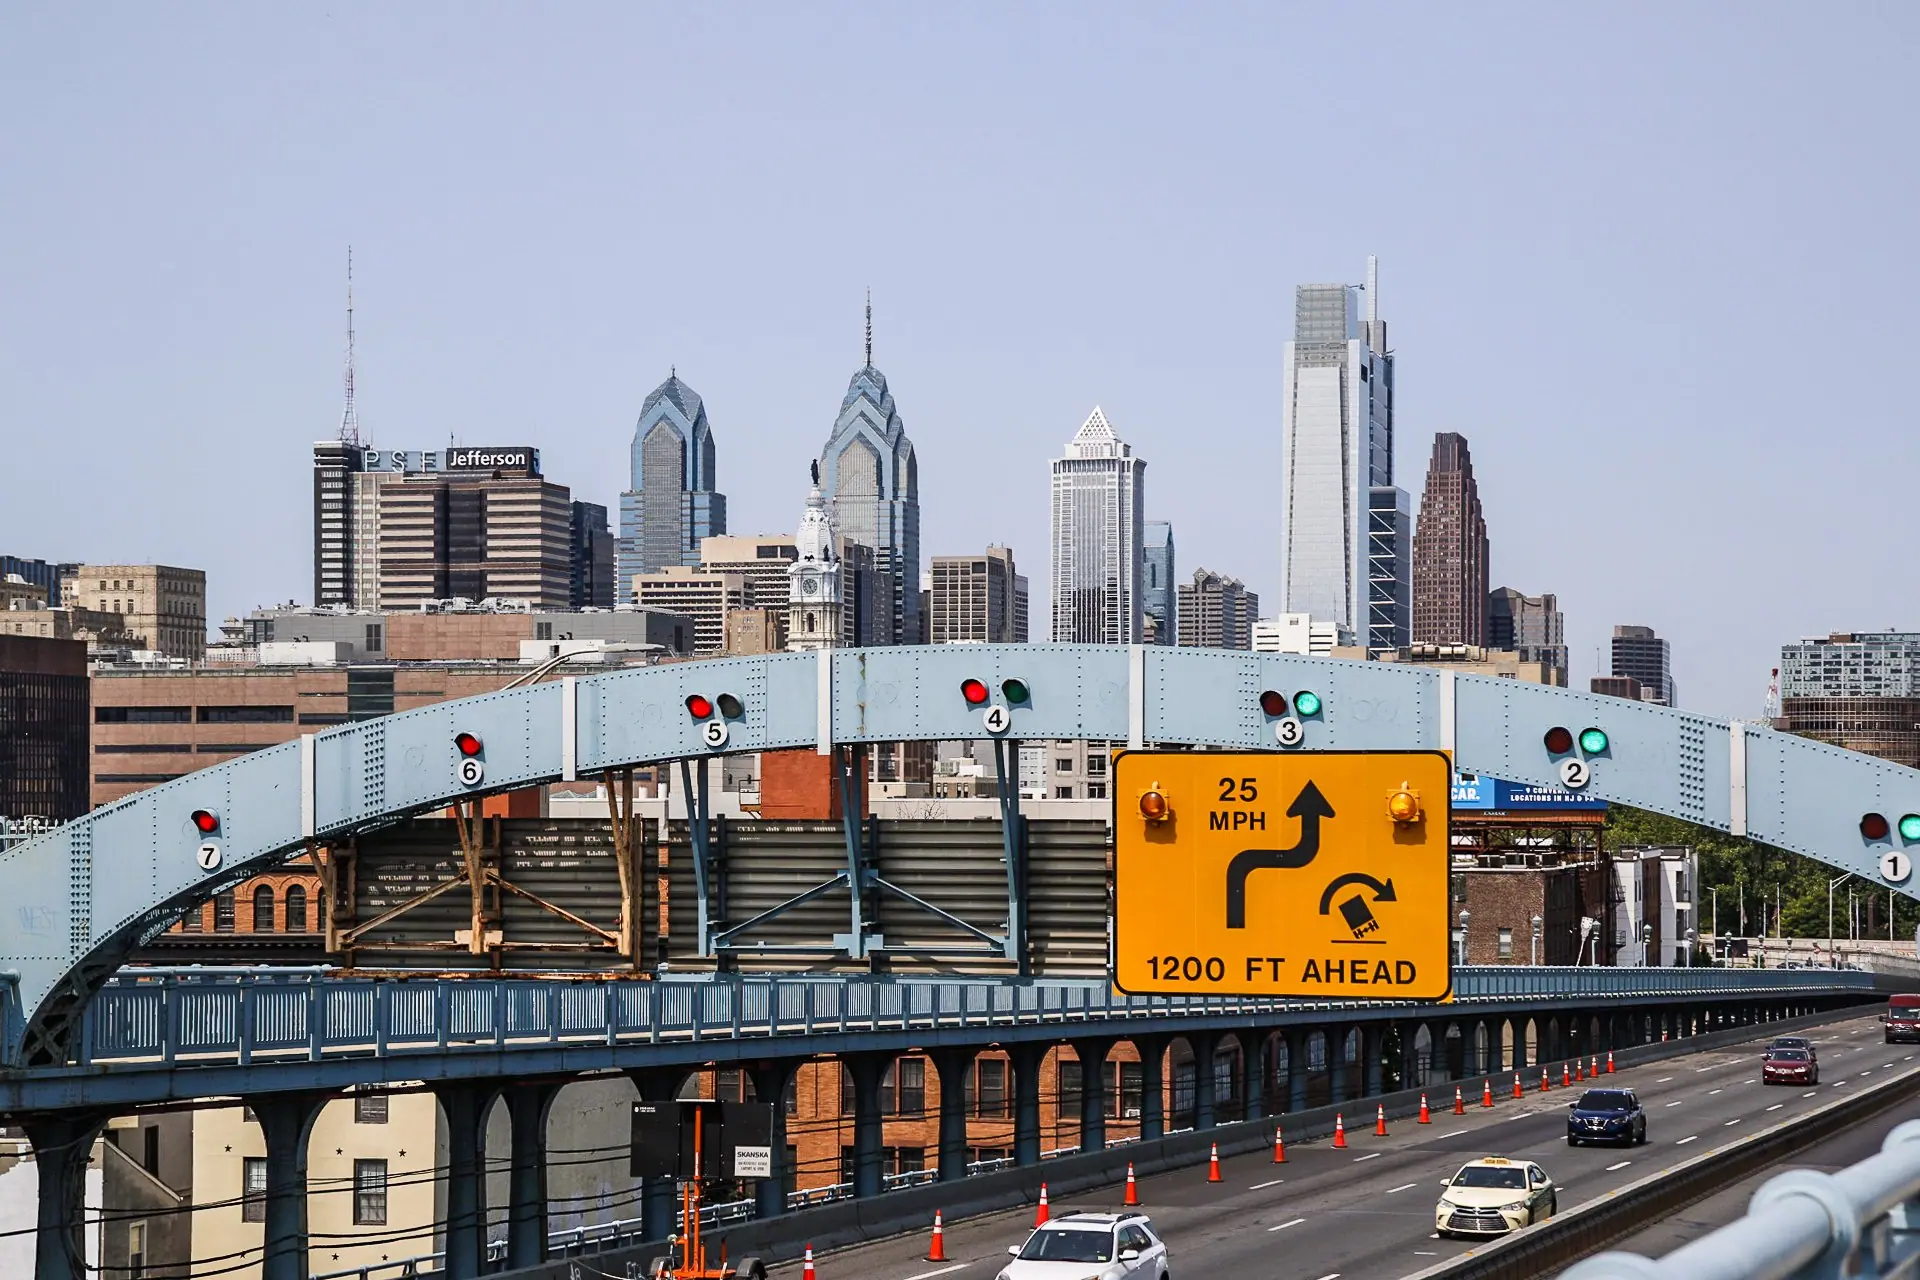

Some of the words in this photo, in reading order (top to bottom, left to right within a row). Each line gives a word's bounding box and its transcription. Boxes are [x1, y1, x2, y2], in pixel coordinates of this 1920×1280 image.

[451, 450, 526, 466] Jefferson
[987, 709, 1003, 728] 4
[707, 722, 722, 742] 5
[1282, 722, 1297, 742] 3
[462, 761, 477, 781] 6
[1567, 762, 1582, 783] 2
[1218, 777, 1258, 803] 25
[1451, 787, 1480, 800] CAR.
[1209, 810, 1266, 831] MPH
[202, 848, 215, 866] 7
[1887, 856, 1898, 877] 1
[1146, 955, 1225, 982] 1200
[1246, 957, 1286, 982] FT
[1301, 958, 1417, 985] AHEAD
[736, 1151, 769, 1159] SKANSKA
